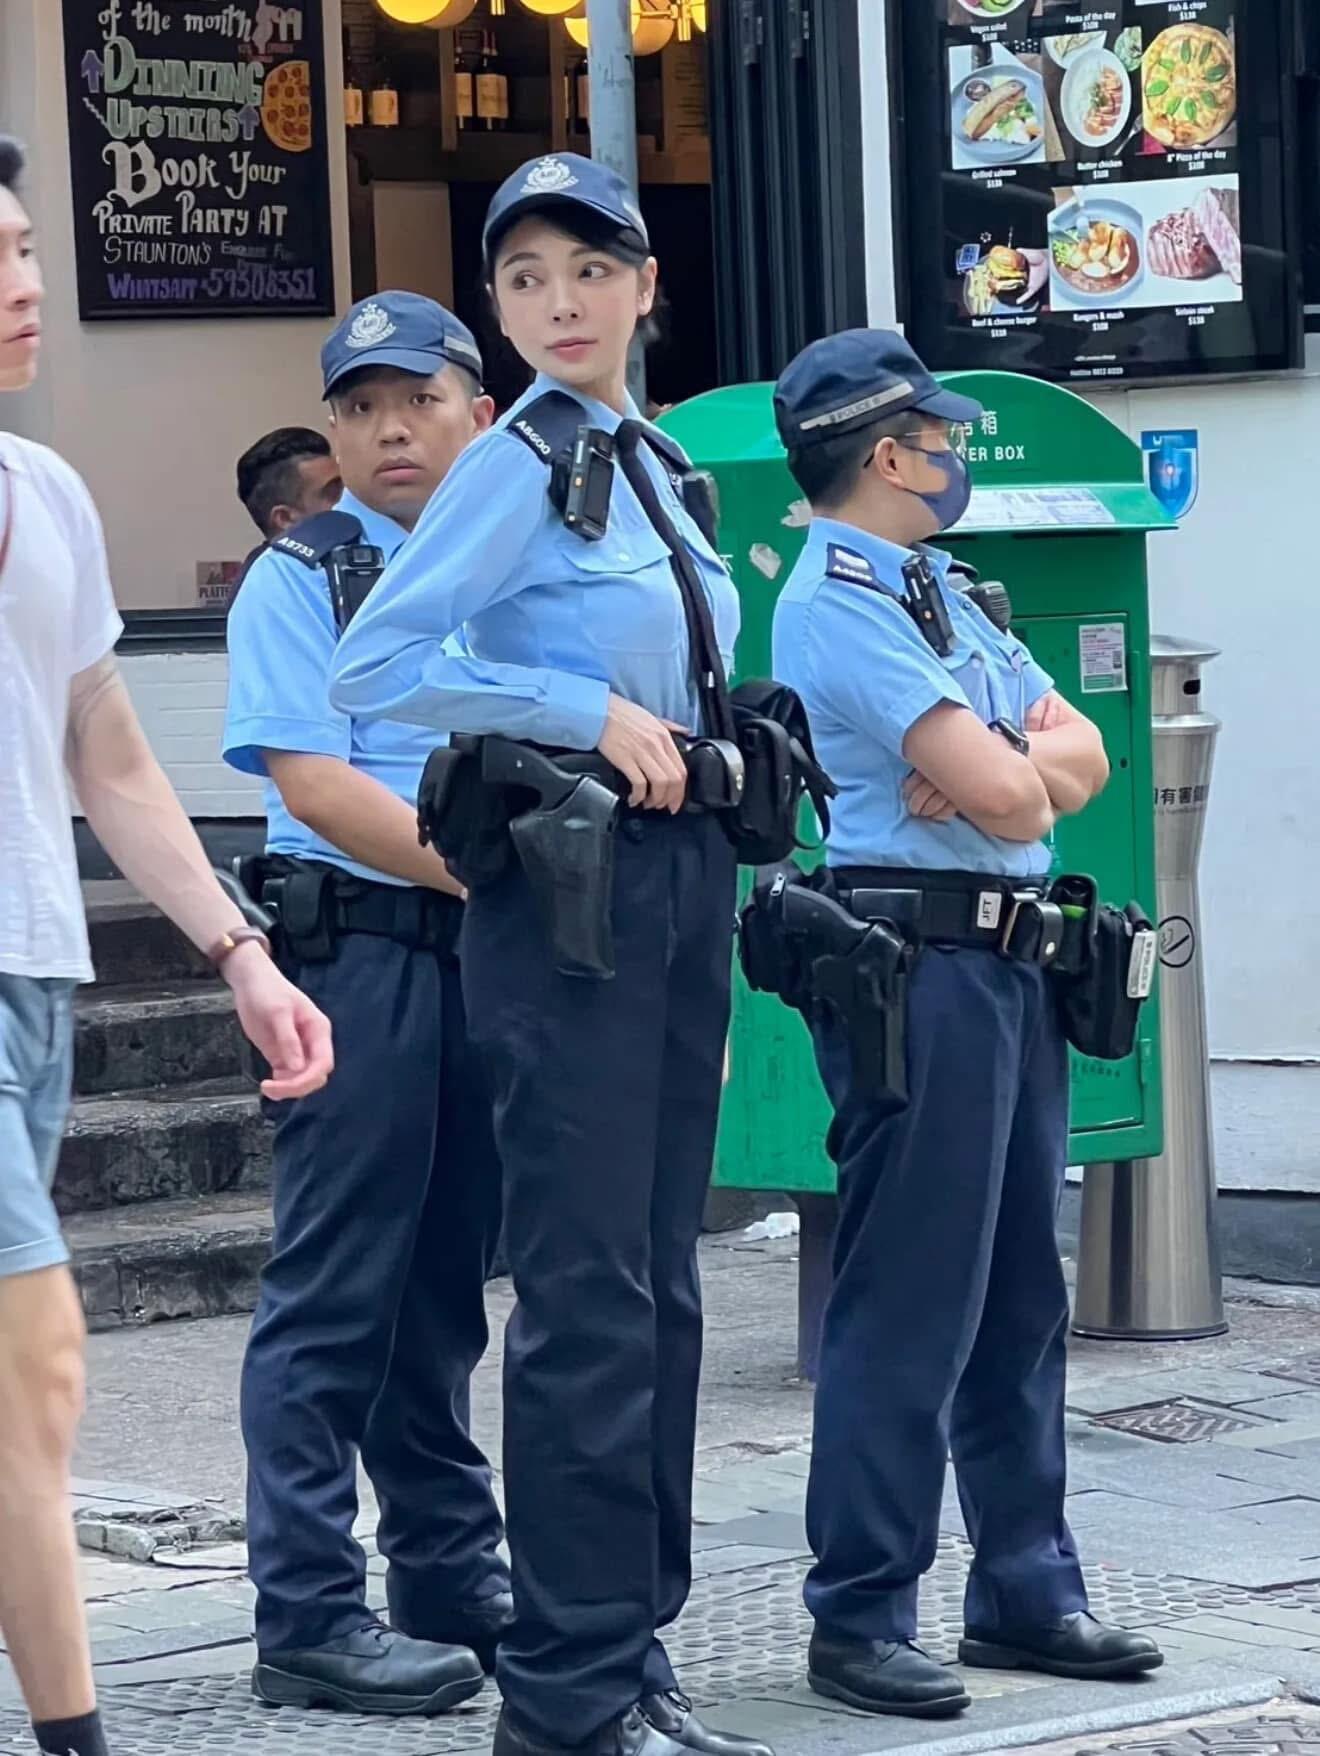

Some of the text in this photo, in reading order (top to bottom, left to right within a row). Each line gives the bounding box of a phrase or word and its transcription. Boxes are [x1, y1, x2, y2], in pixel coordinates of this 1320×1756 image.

[98, 0, 252, 42] of the month
[258, 205, 288, 236] AT
[994, 445, 1025, 461] BOX
